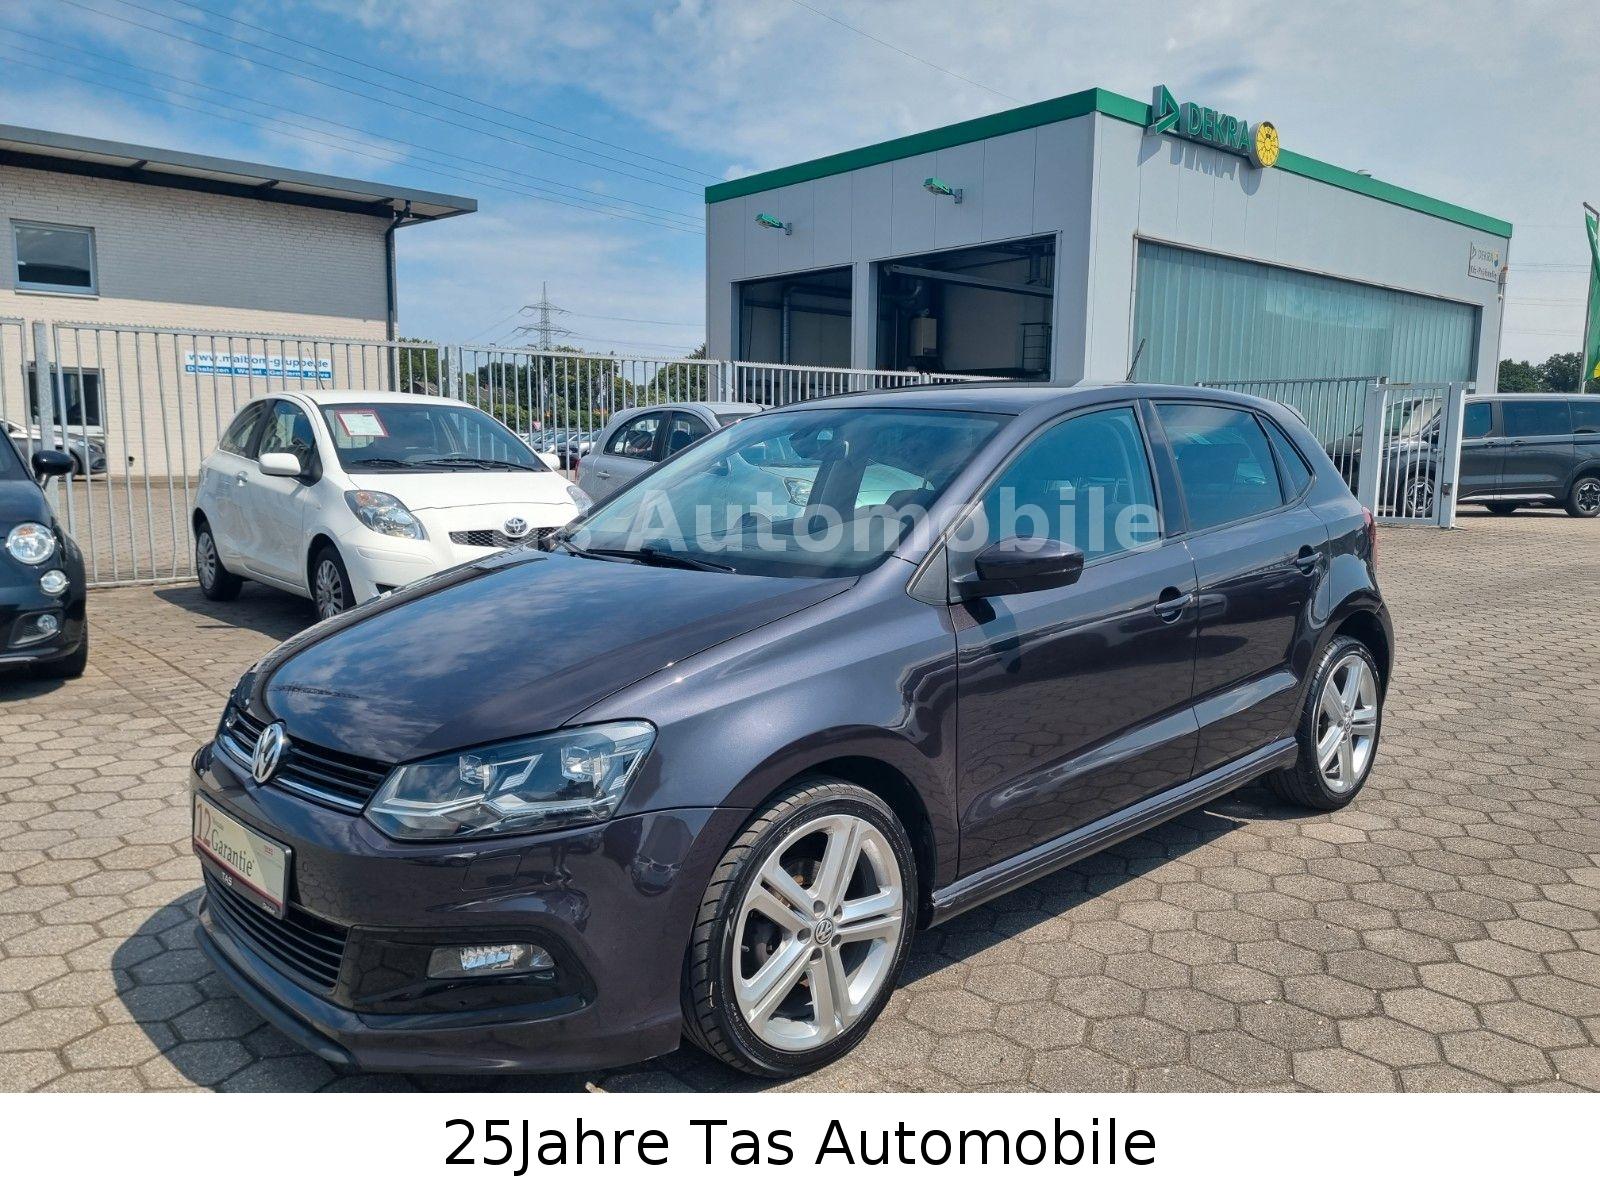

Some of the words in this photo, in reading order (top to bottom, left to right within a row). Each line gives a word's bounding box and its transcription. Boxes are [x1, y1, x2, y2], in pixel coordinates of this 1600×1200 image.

[1186, 101, 1251, 150] DEKRA
[187, 365, 230, 374] Dnslaken
[188, 353, 329, 368] www.maibom-guppe.de
[211, 828, 254, 877] Garantie
